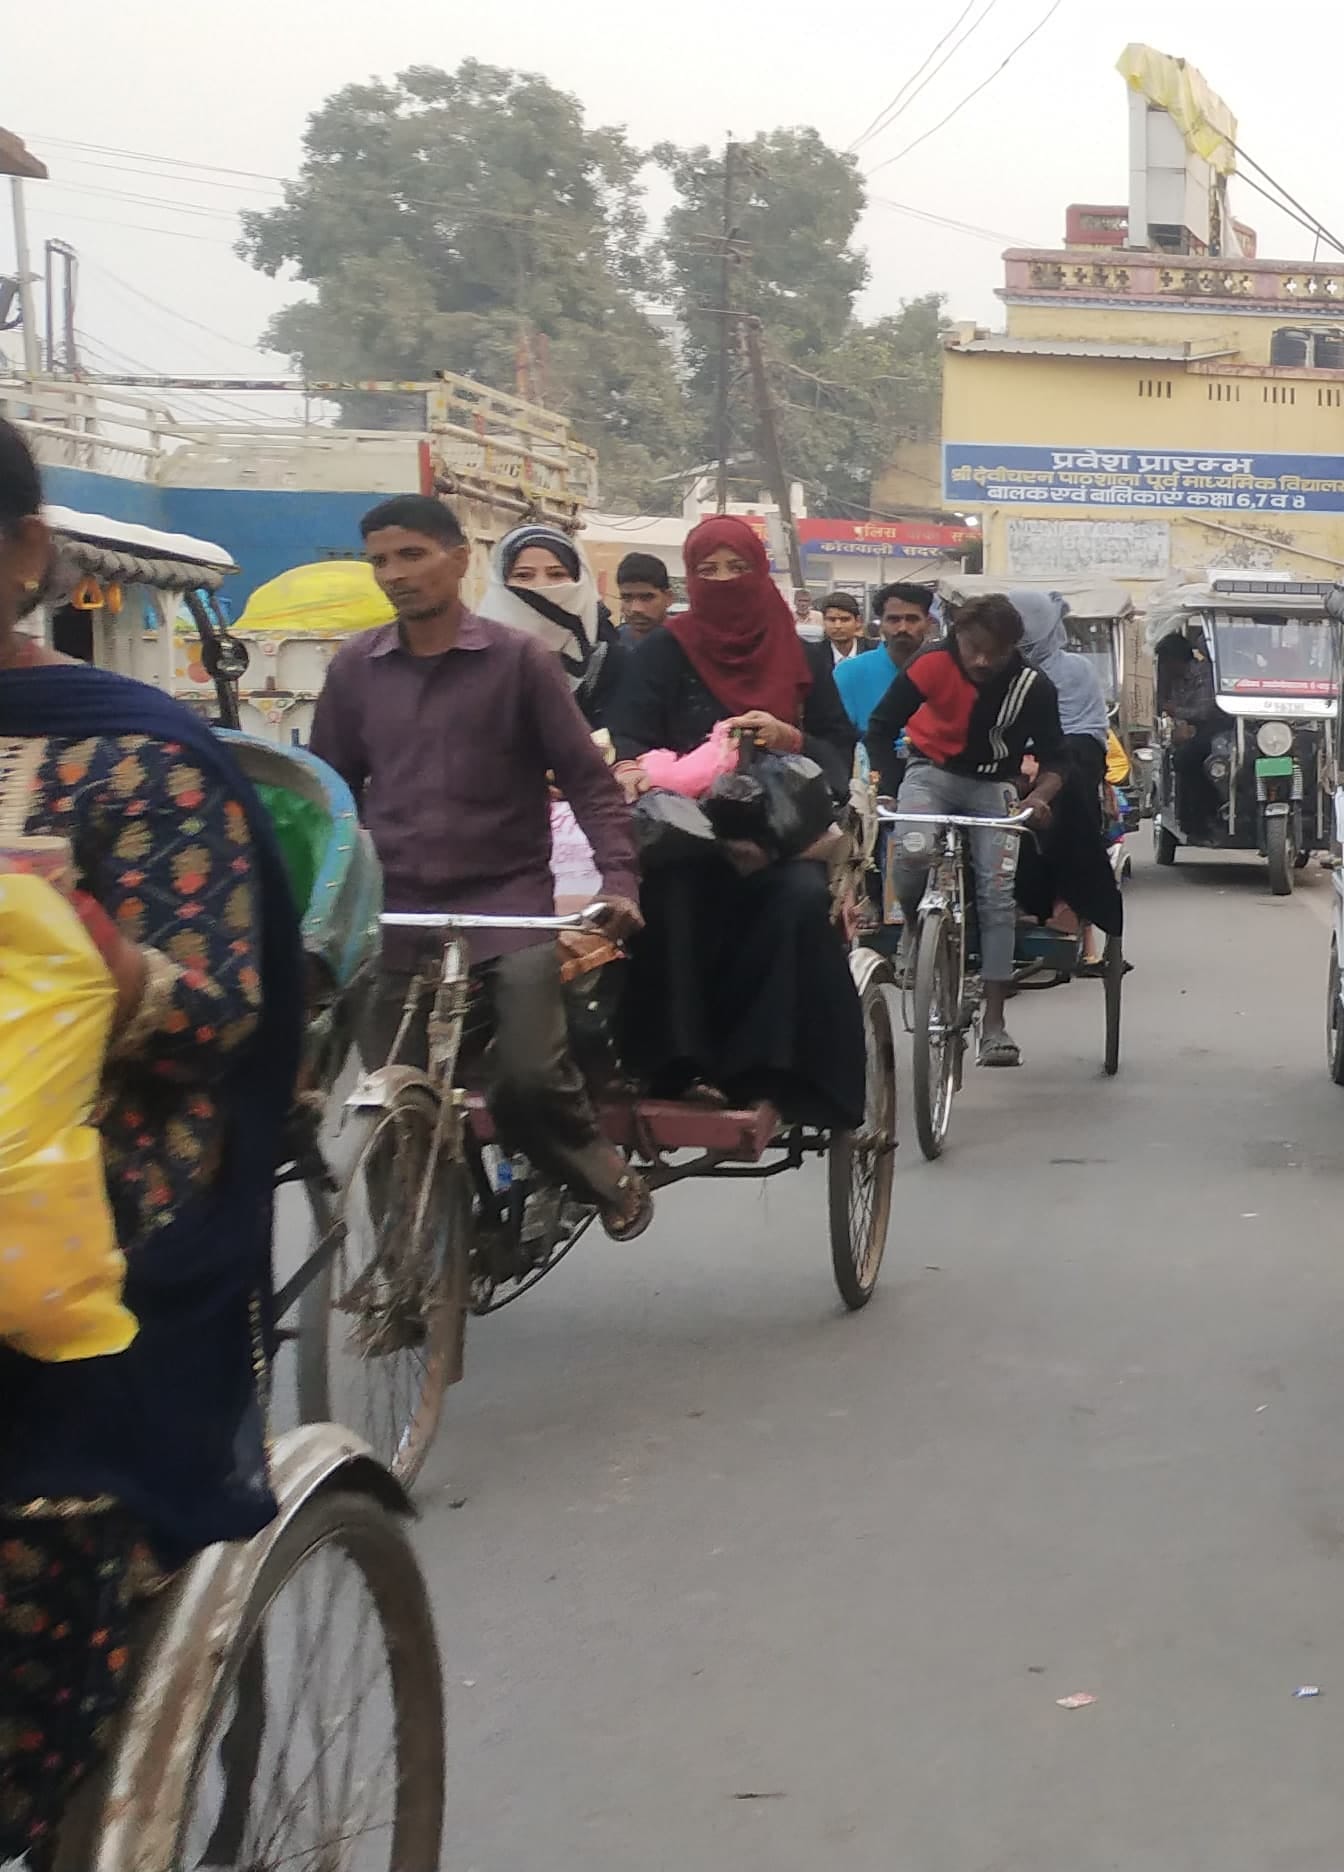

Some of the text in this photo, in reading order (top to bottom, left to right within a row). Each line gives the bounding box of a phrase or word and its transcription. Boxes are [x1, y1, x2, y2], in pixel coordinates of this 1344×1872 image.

[1051, 449, 1254, 475] प्रवेश प्रारम्भ
[1057, 470, 1141, 489] पाठशाला
[1143, 471, 1181, 492] पूर्व
[1182, 473, 1277, 491] माध्यमिक
[986, 485, 1048, 501] बालक
